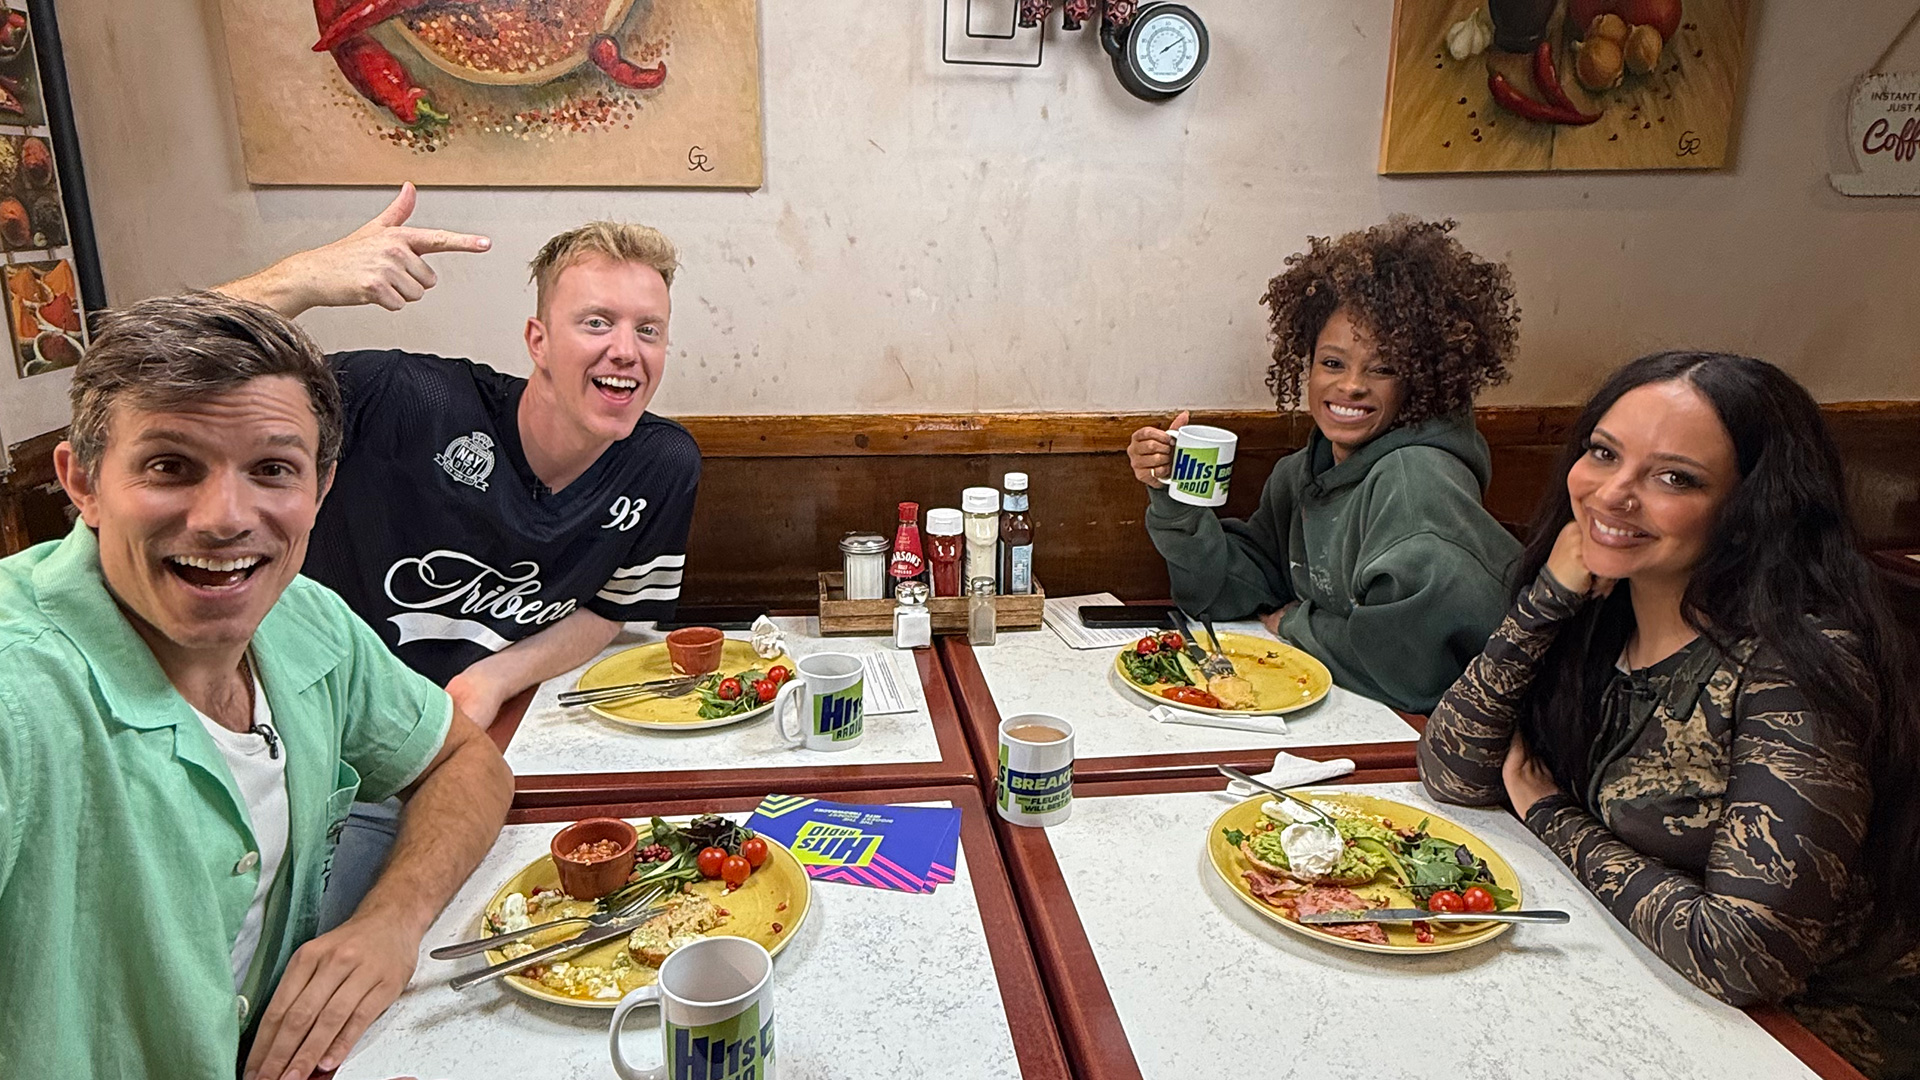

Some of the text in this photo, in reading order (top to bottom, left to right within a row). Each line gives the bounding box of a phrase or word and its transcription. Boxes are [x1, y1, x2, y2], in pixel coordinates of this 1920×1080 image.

[1871, 92, 1917, 101] INSTANT
[1886, 103, 1914, 112] JUST
[1173, 449, 1213, 480] HITS
[1179, 480, 1210, 494] RADIO
[601, 496, 647, 531] 93
[384, 550, 577, 624] Tribeca
[1031, 793, 1060, 805] FLEUR
[1024, 804, 1046, 812] WILL
[808, 826, 857, 837] RADIO
[797, 835, 875, 865] HITS
[675, 1028, 756, 1080] HITS
